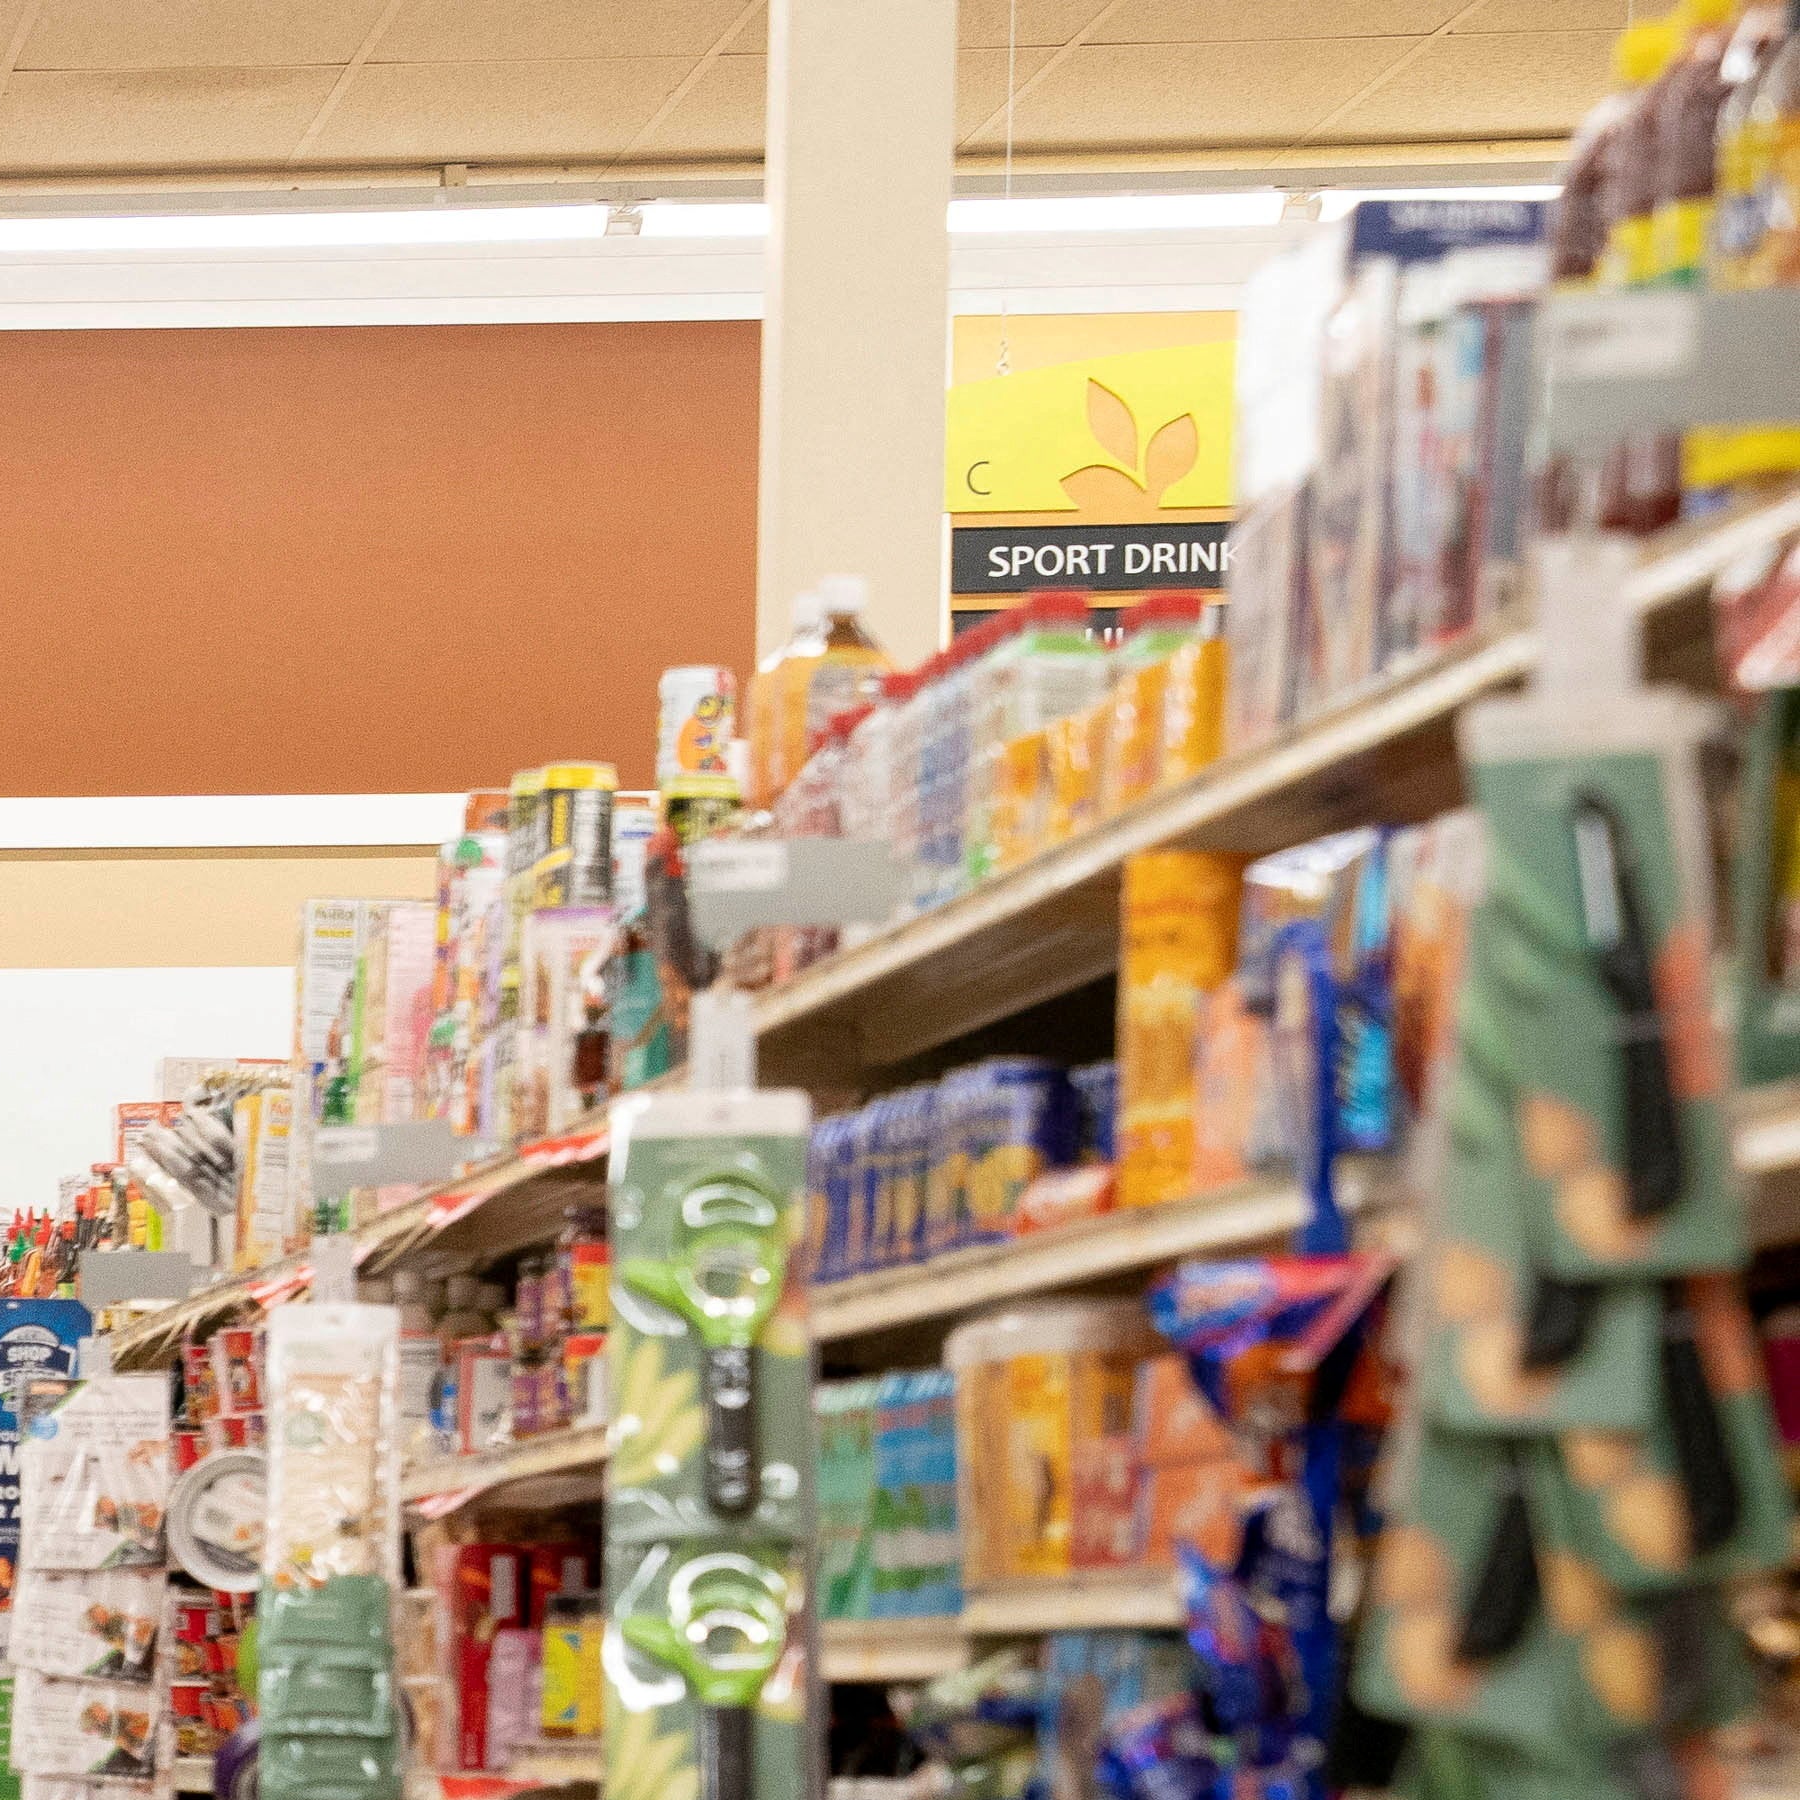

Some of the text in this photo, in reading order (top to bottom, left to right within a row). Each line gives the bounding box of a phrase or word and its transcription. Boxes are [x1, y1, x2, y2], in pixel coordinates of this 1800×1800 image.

[967, 461, 991, 495] C
[988, 542, 1240, 578] SPORT DRINK
